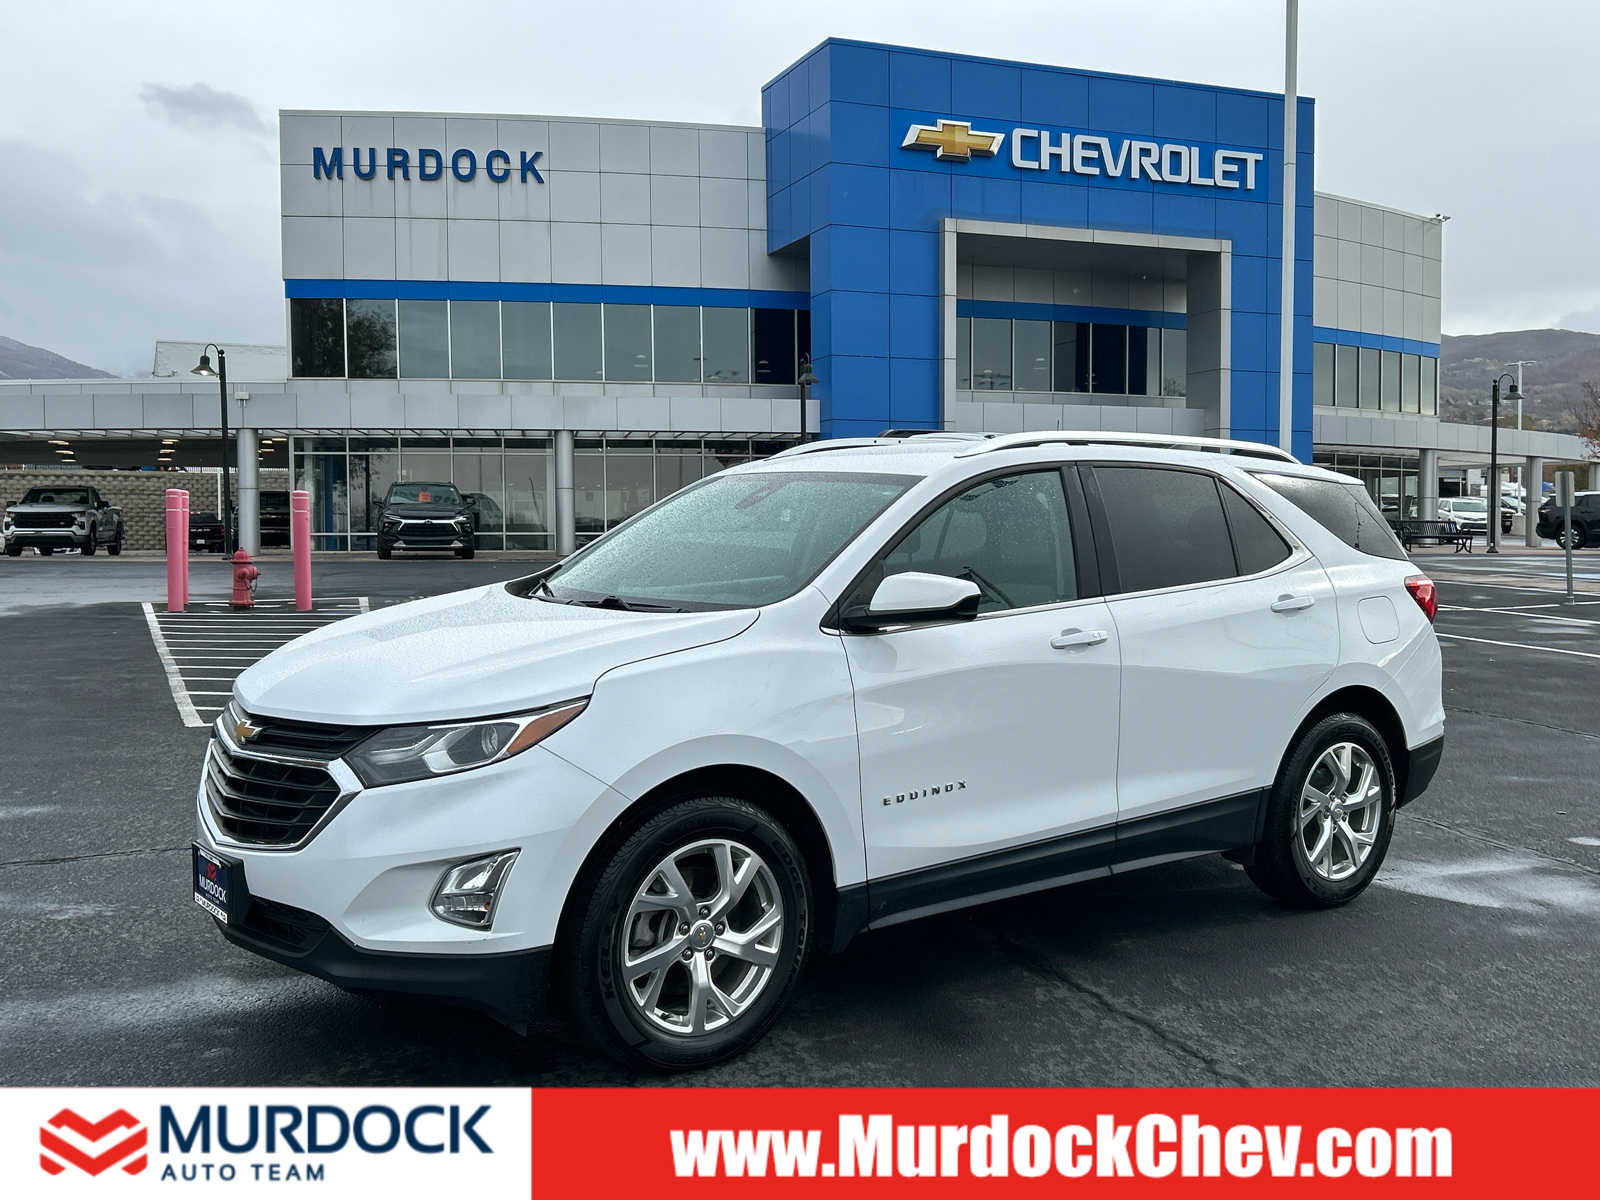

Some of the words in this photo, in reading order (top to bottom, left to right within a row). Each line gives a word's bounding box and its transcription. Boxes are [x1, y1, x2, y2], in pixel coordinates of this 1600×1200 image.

[313, 147, 545, 184] MURDOCK
[1012, 128, 1263, 190] CHEVROLET
[882, 781, 967, 807] EQUINOX
[198, 873, 227, 904] MURDOCK
